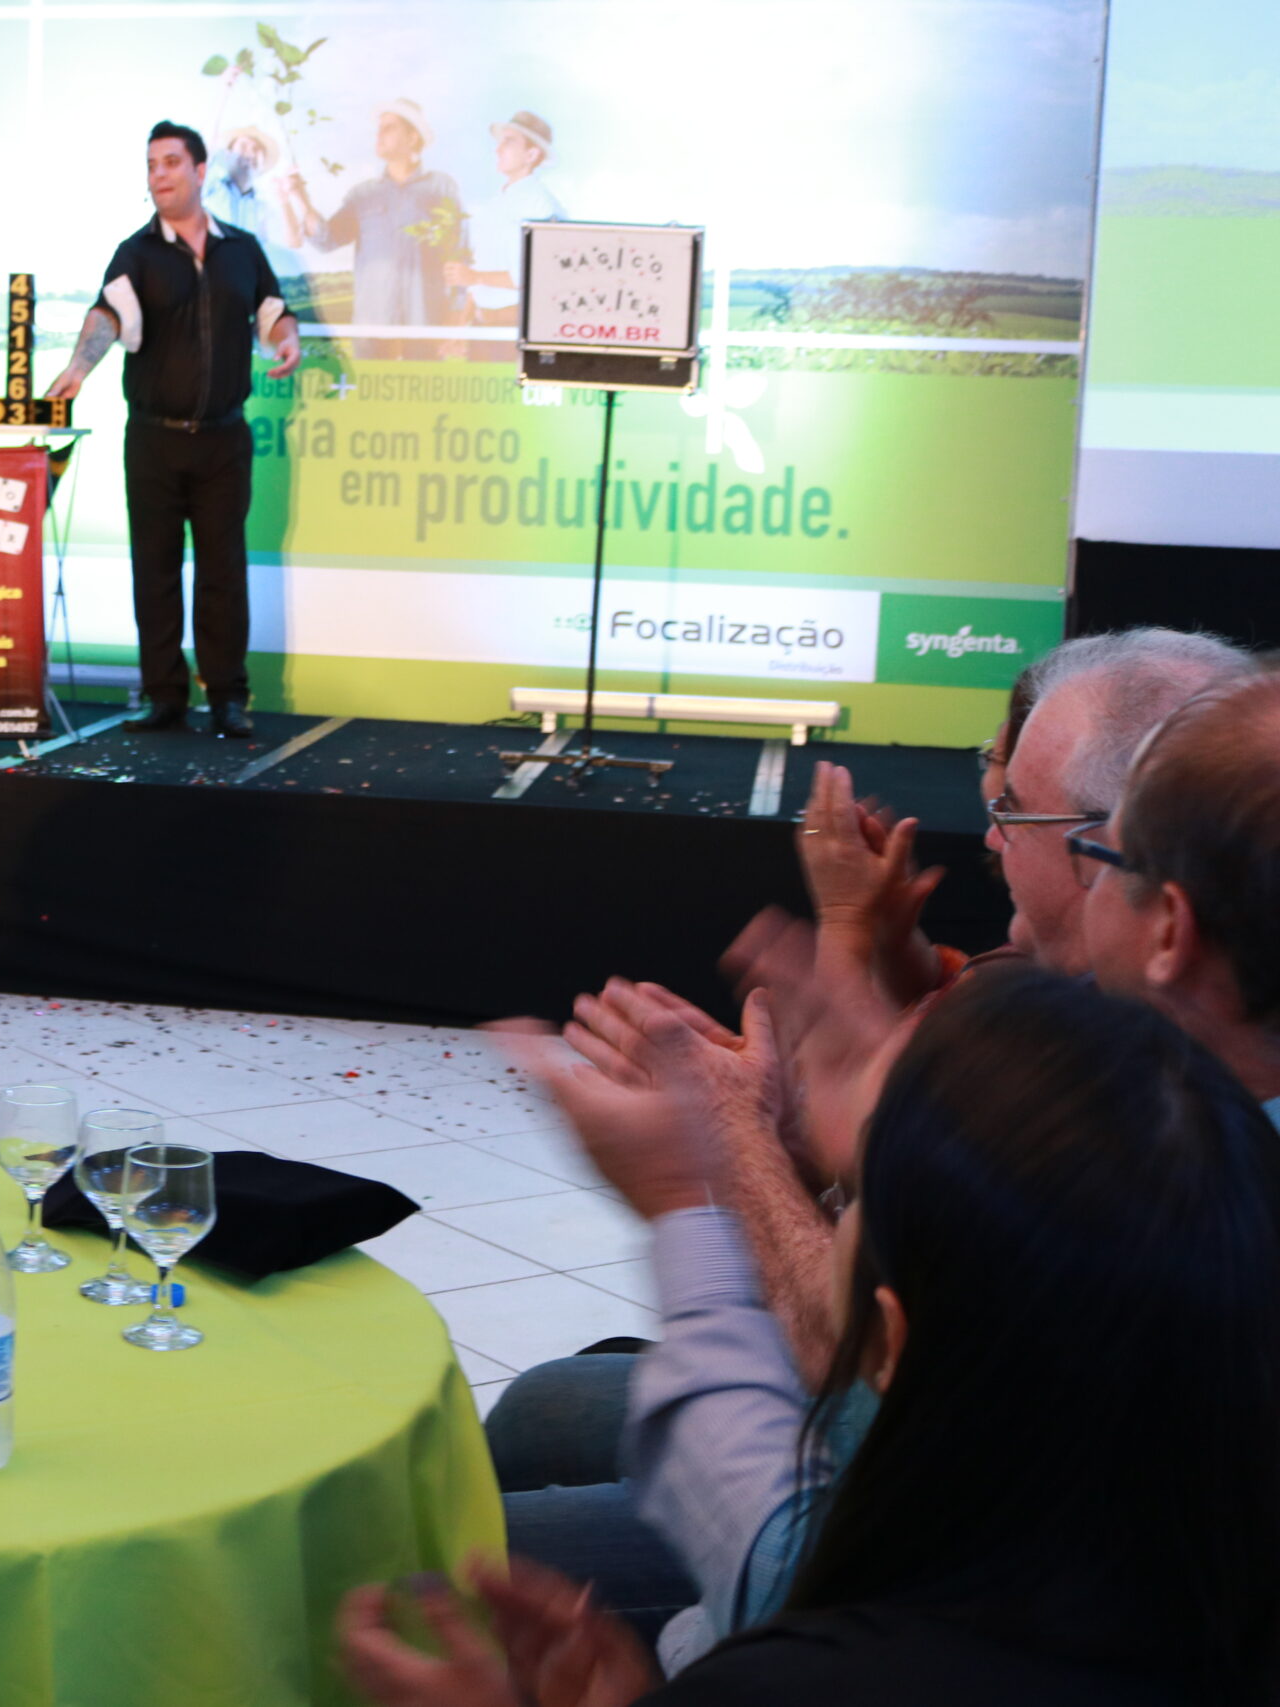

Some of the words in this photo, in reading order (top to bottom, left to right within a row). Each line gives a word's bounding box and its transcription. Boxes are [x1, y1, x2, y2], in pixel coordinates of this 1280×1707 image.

[358, 372, 516, 405] DISTRIBUIDOR
[350, 428, 420, 462] com
[433, 413, 520, 463] foco
[340, 467, 400, 507] em
[415, 457, 850, 543] produtividade.
[610, 610, 845, 656] Focalização
[905, 625, 1020, 658] syngenta
